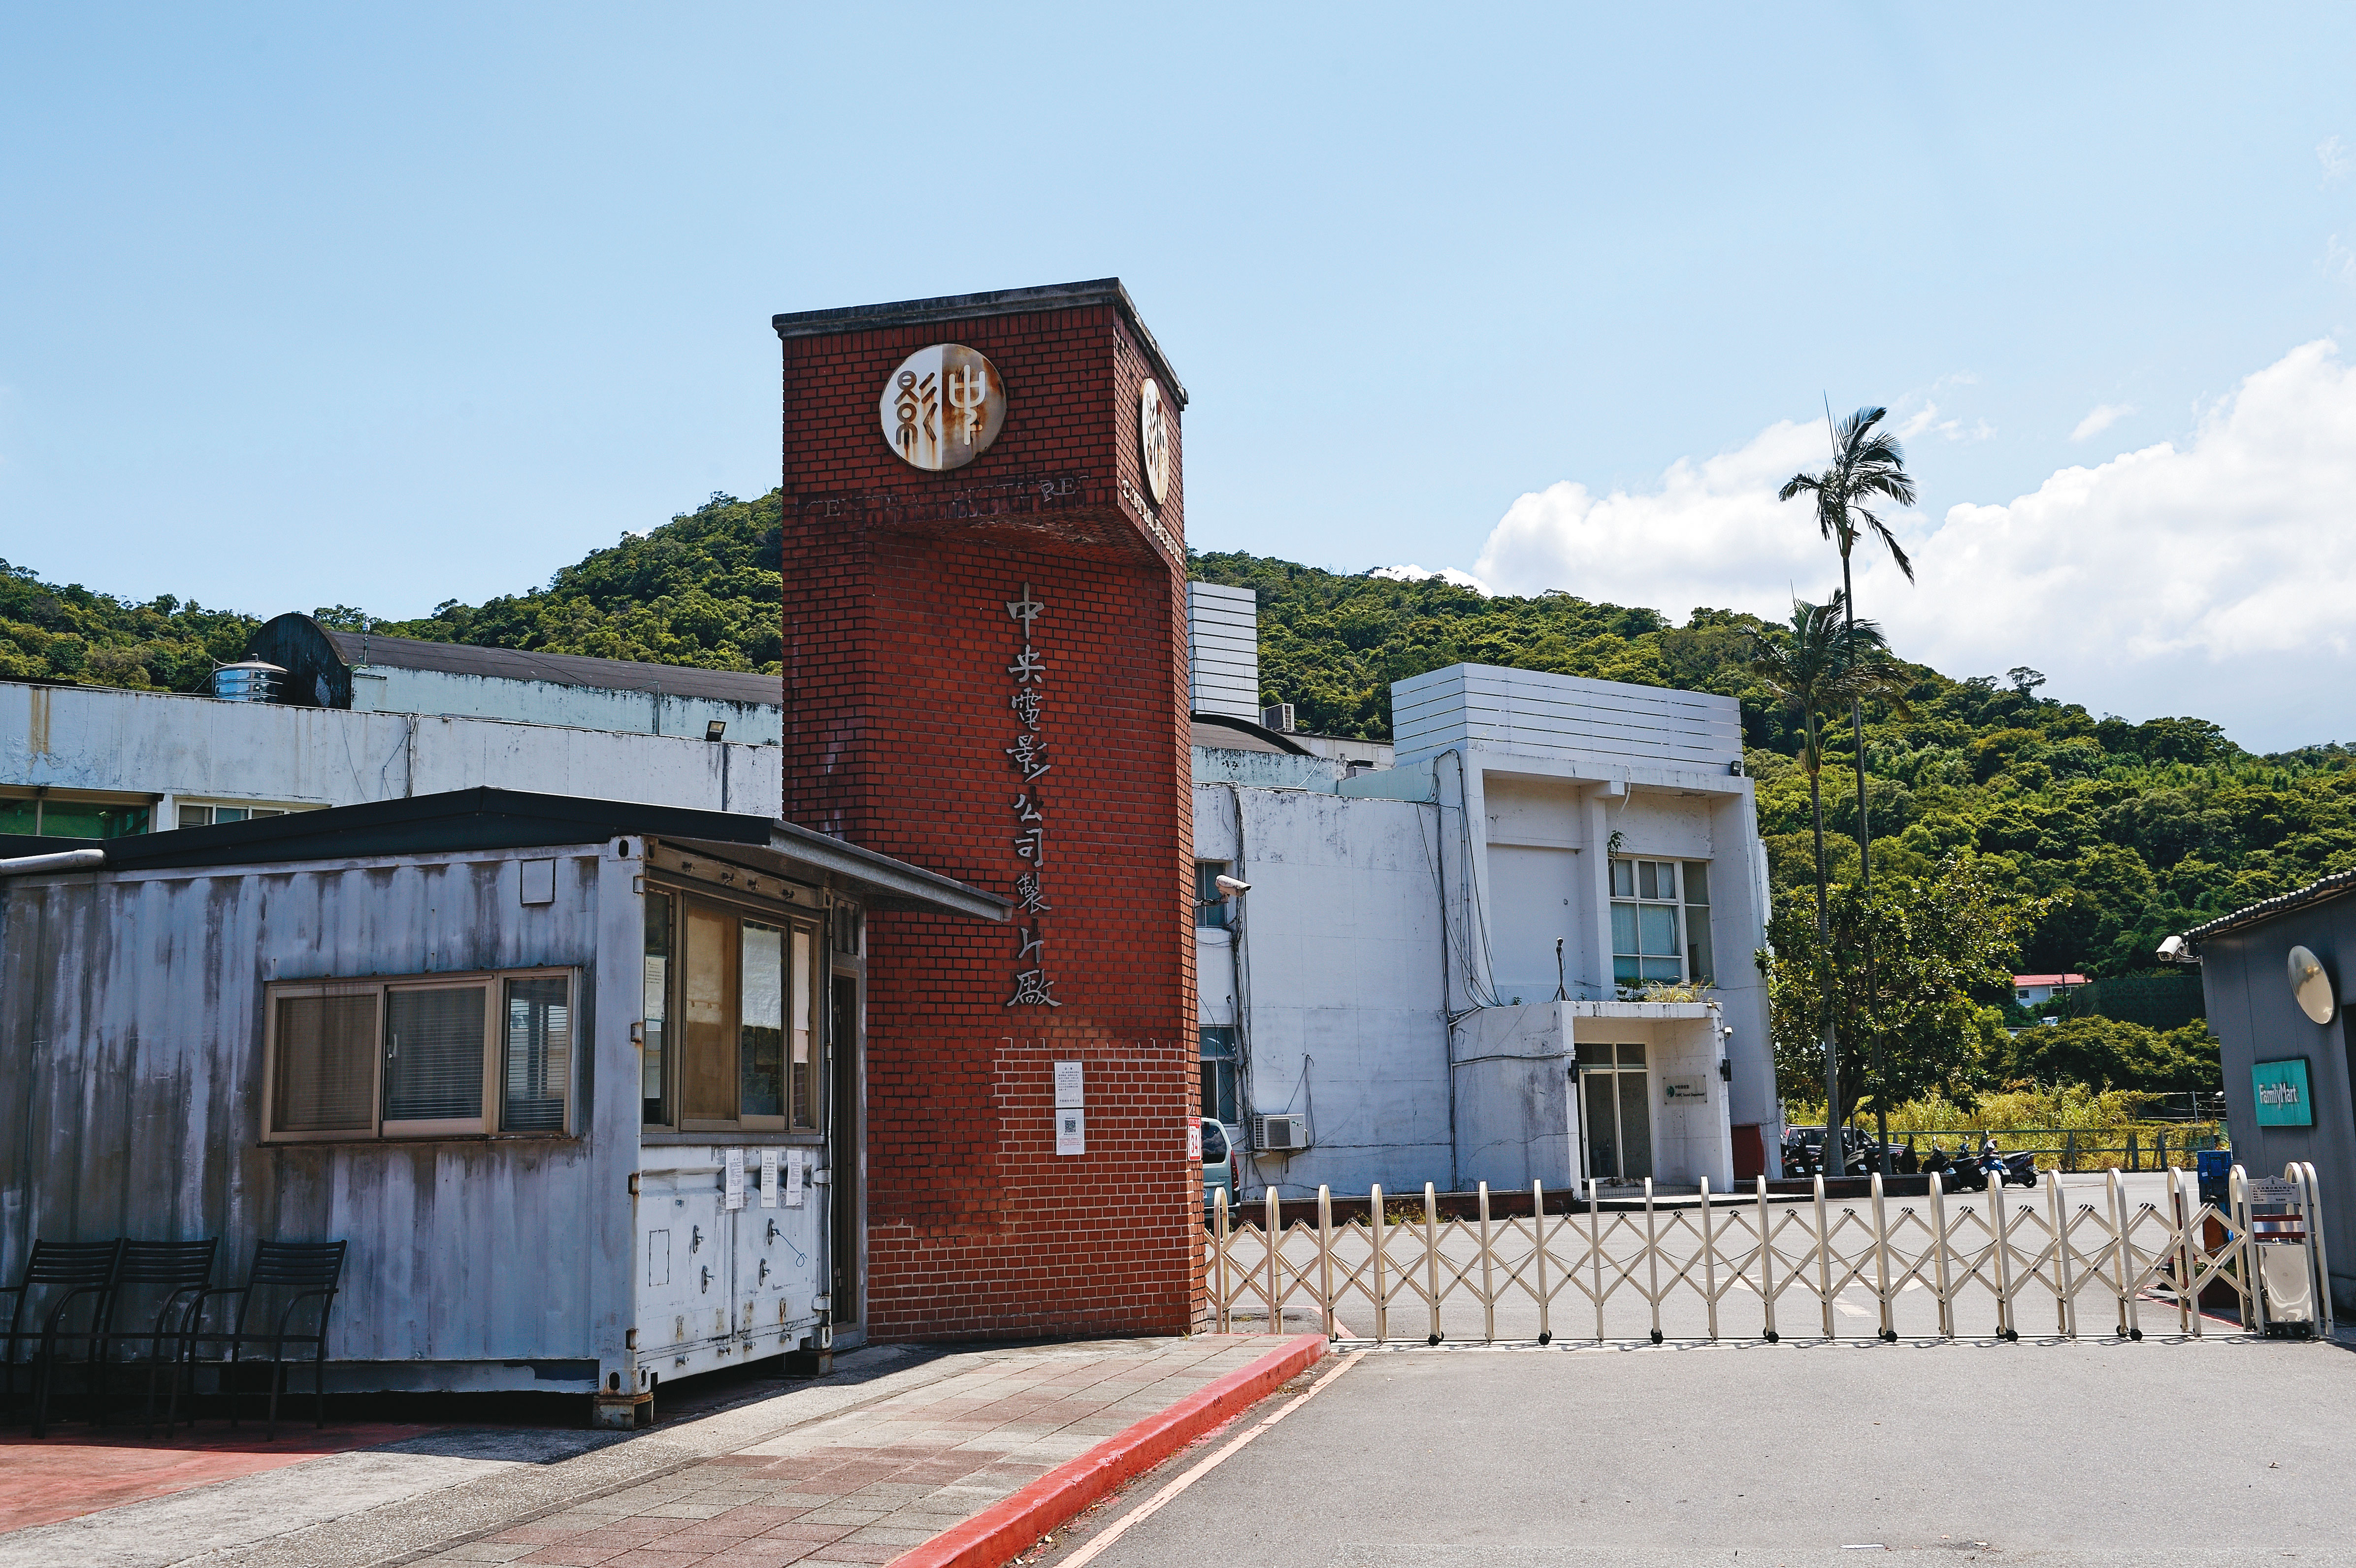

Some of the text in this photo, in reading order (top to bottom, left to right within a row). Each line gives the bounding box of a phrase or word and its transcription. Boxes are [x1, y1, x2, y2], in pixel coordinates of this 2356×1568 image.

[1006, 582, 1062, 1006] 中央電影公司製片廠
[2259, 1083, 2297, 1109] FamilyMart
[1191, 1135, 1198, 1153] 34
